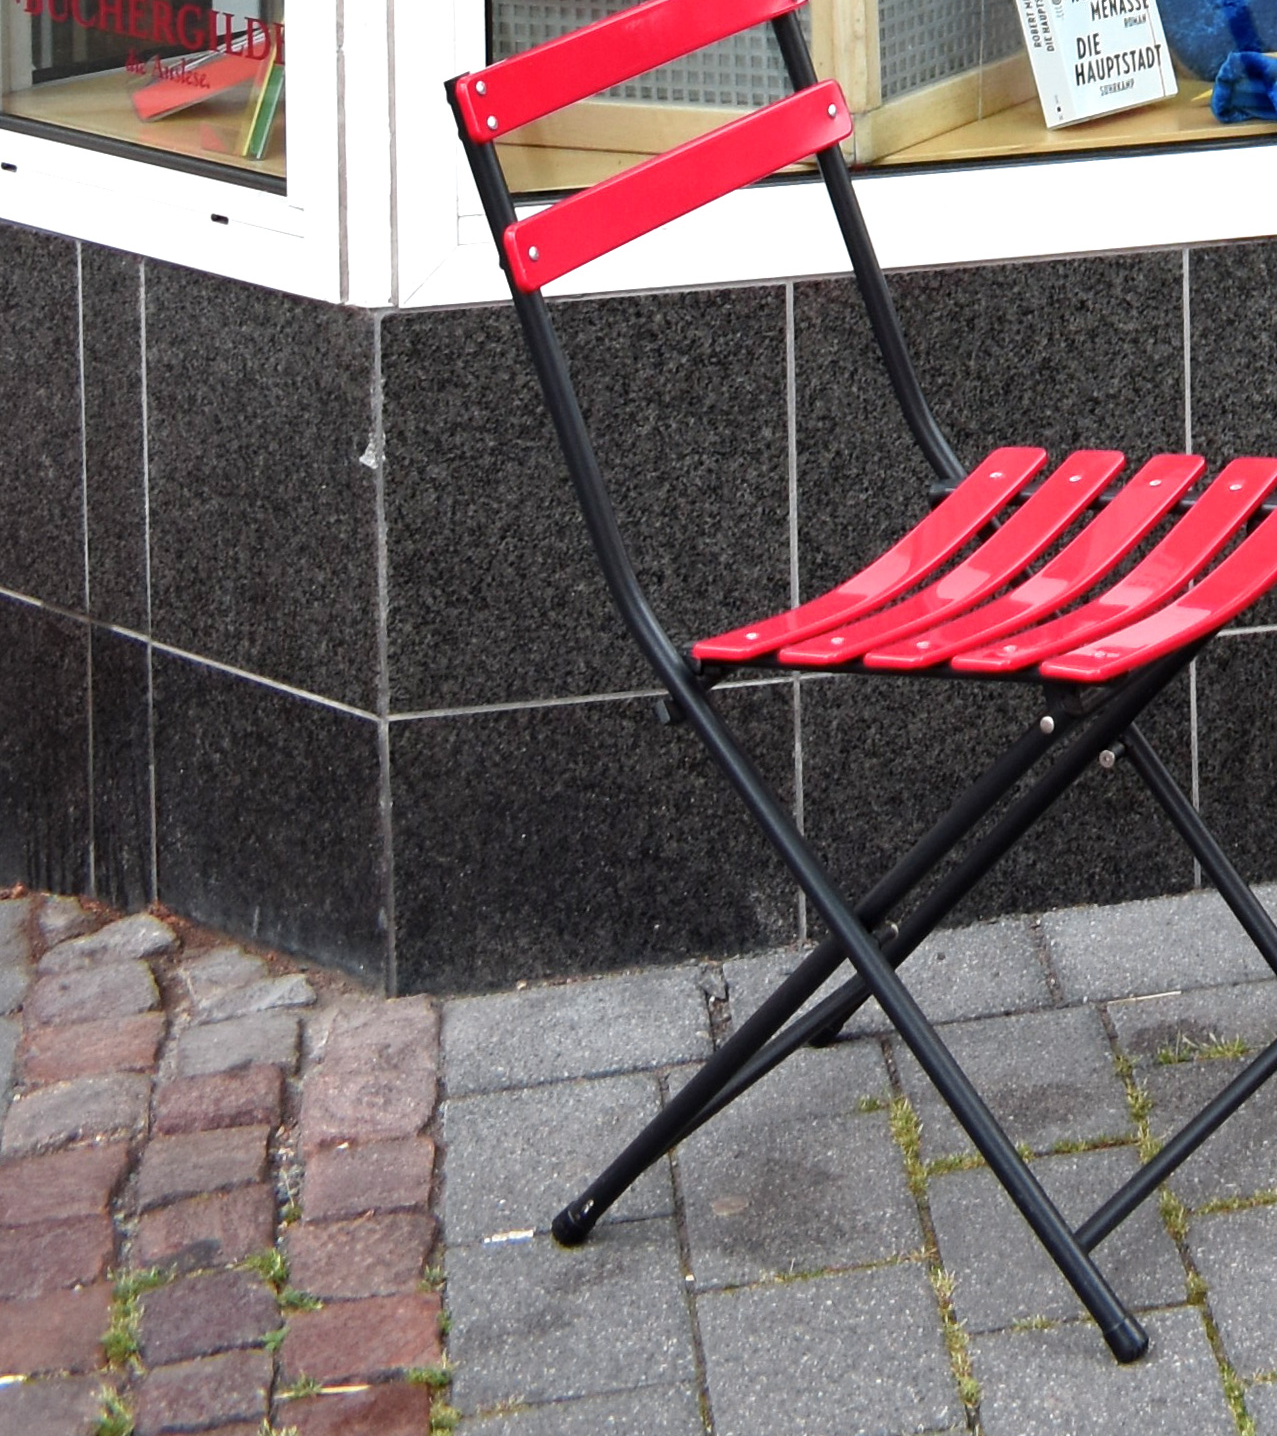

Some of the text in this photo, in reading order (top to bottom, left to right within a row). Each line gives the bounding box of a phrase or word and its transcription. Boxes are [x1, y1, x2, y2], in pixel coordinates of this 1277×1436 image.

[1027, 13, 1043, 48] ROBERT
[1040, 34, 1055, 52] DIE
[1076, 33, 1101, 60] DIE
[1074, 44, 1162, 87] HAUPTSTADT
